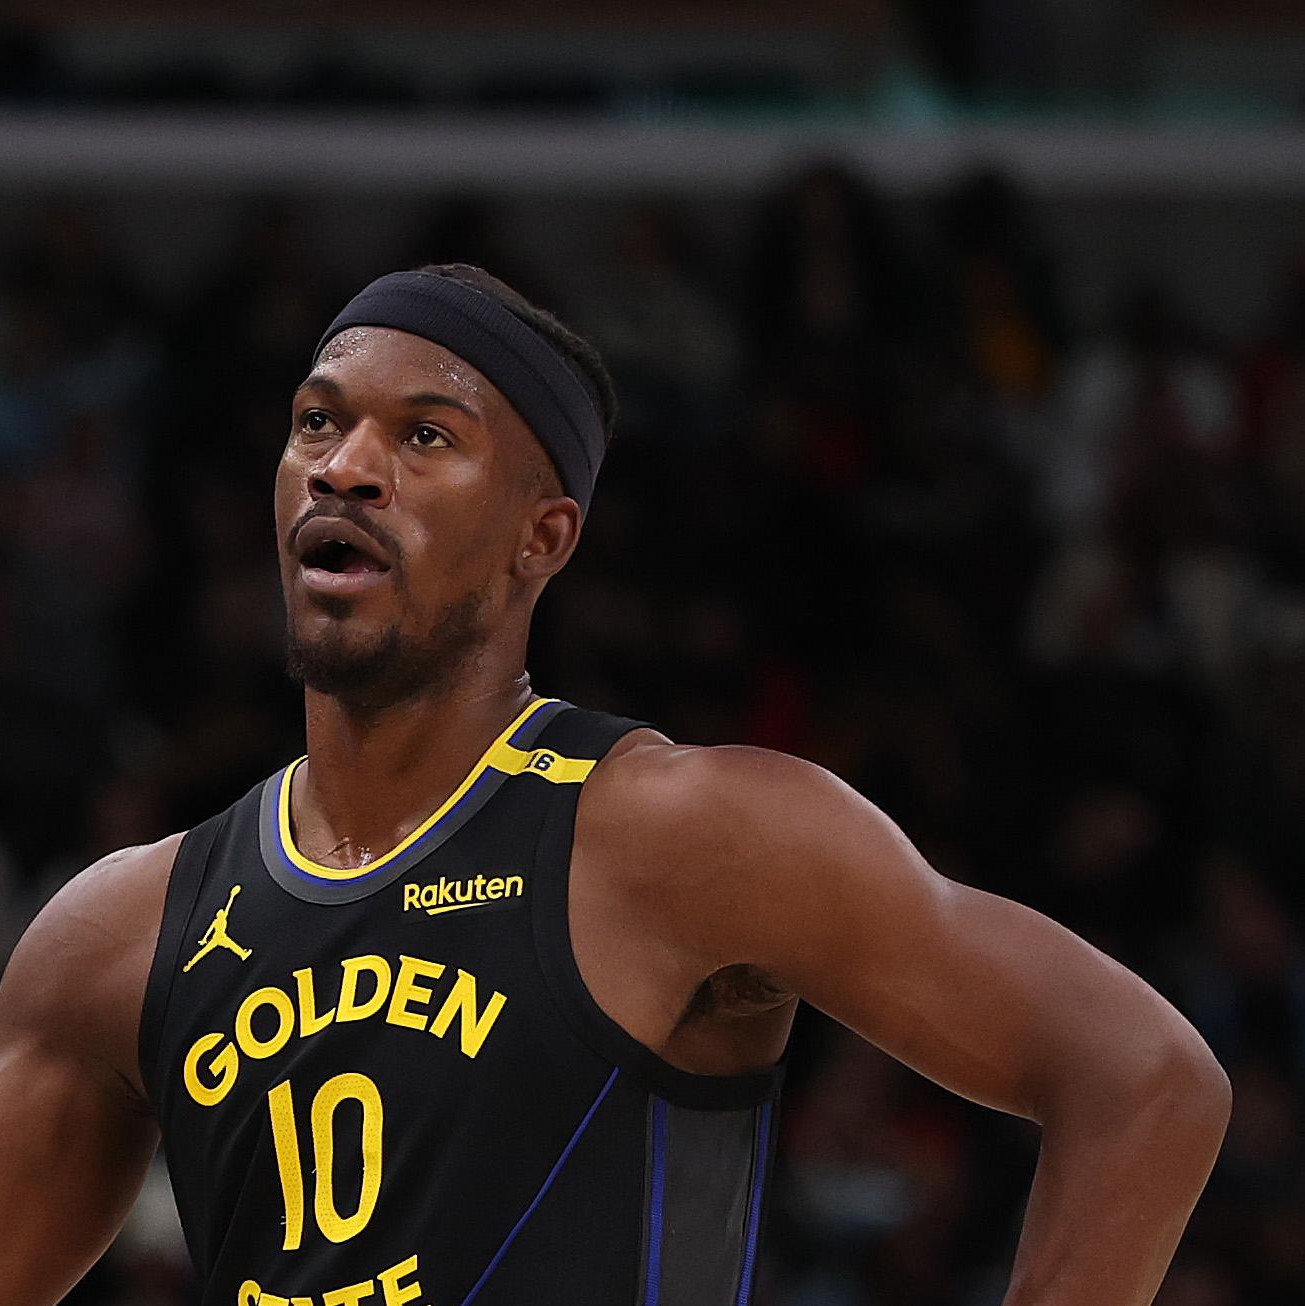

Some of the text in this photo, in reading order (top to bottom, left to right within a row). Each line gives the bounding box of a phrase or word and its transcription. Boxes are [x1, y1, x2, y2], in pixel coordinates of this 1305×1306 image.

[403, 874, 524, 912] Rakuten
[183, 954, 508, 1107] GOLDEN
[268, 1072, 384, 1252] 10
